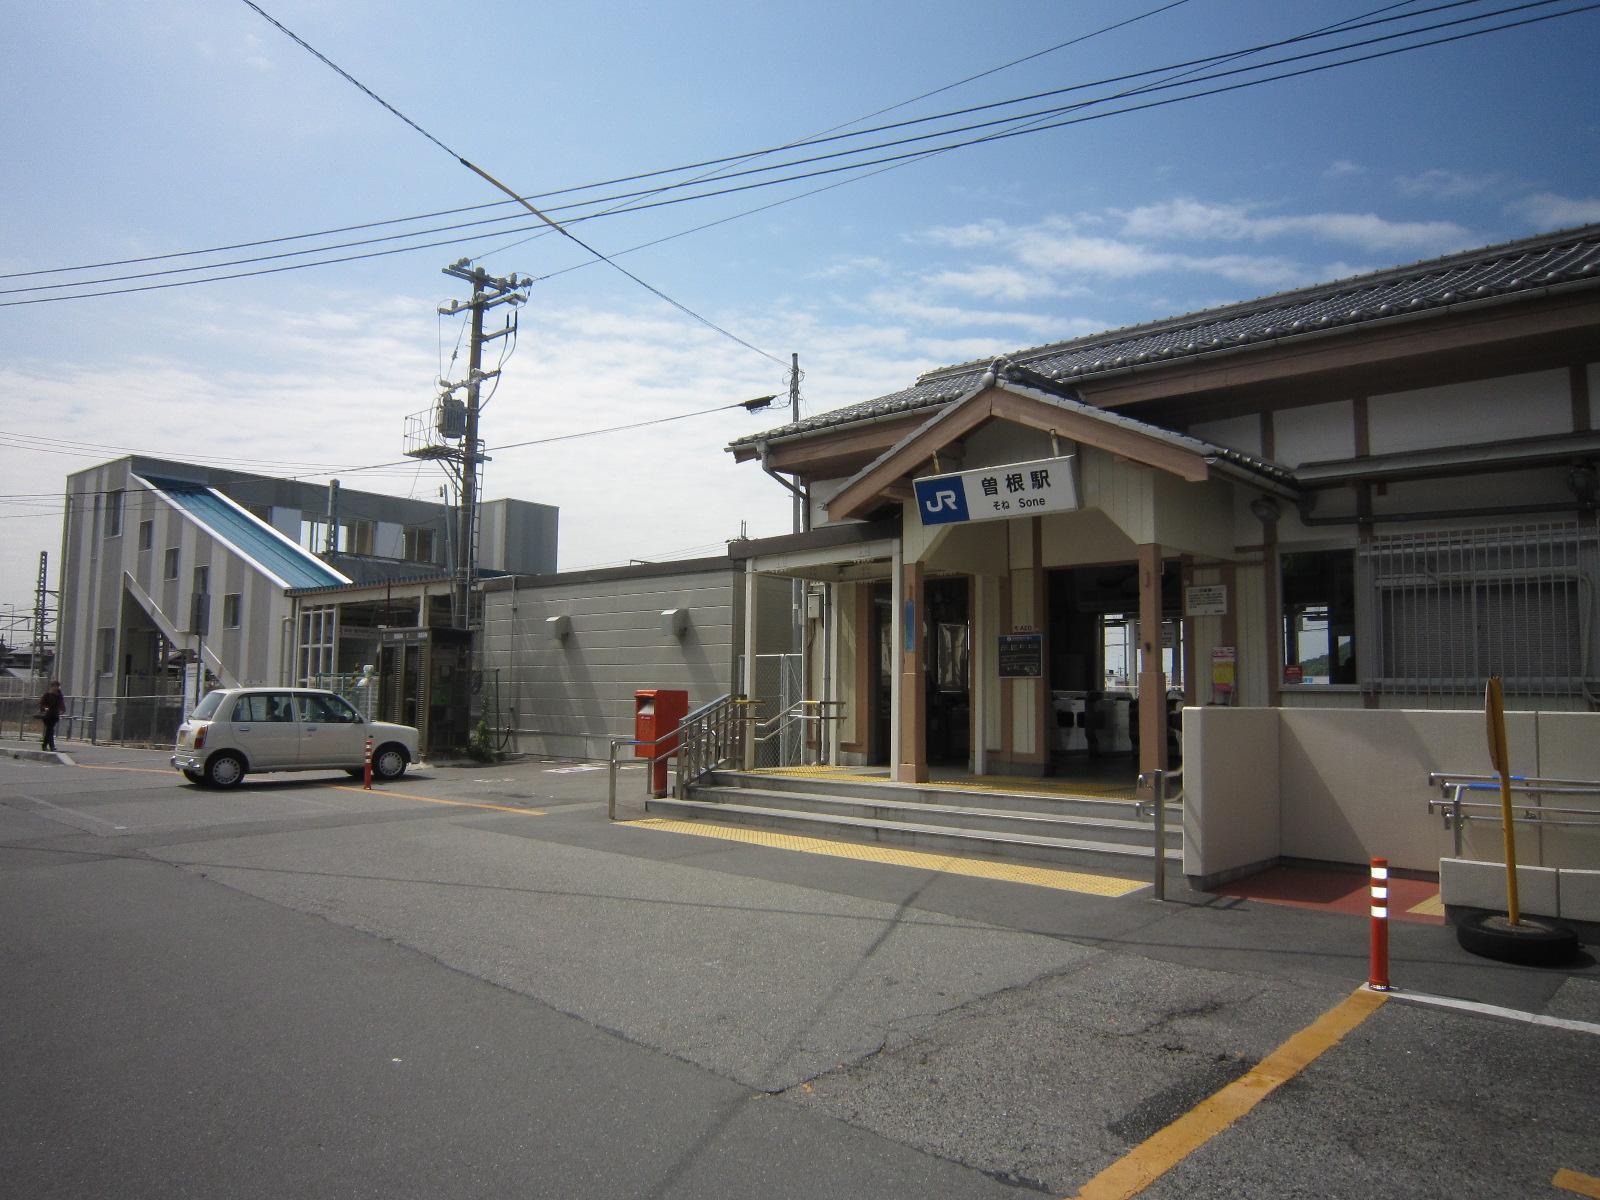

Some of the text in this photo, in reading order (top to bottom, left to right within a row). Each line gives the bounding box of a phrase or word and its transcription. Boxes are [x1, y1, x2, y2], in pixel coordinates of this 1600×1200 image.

[981, 469, 1051, 497] 曽根駅
[926, 490, 958, 513] JR
[993, 497, 1046, 511] そね Sone
